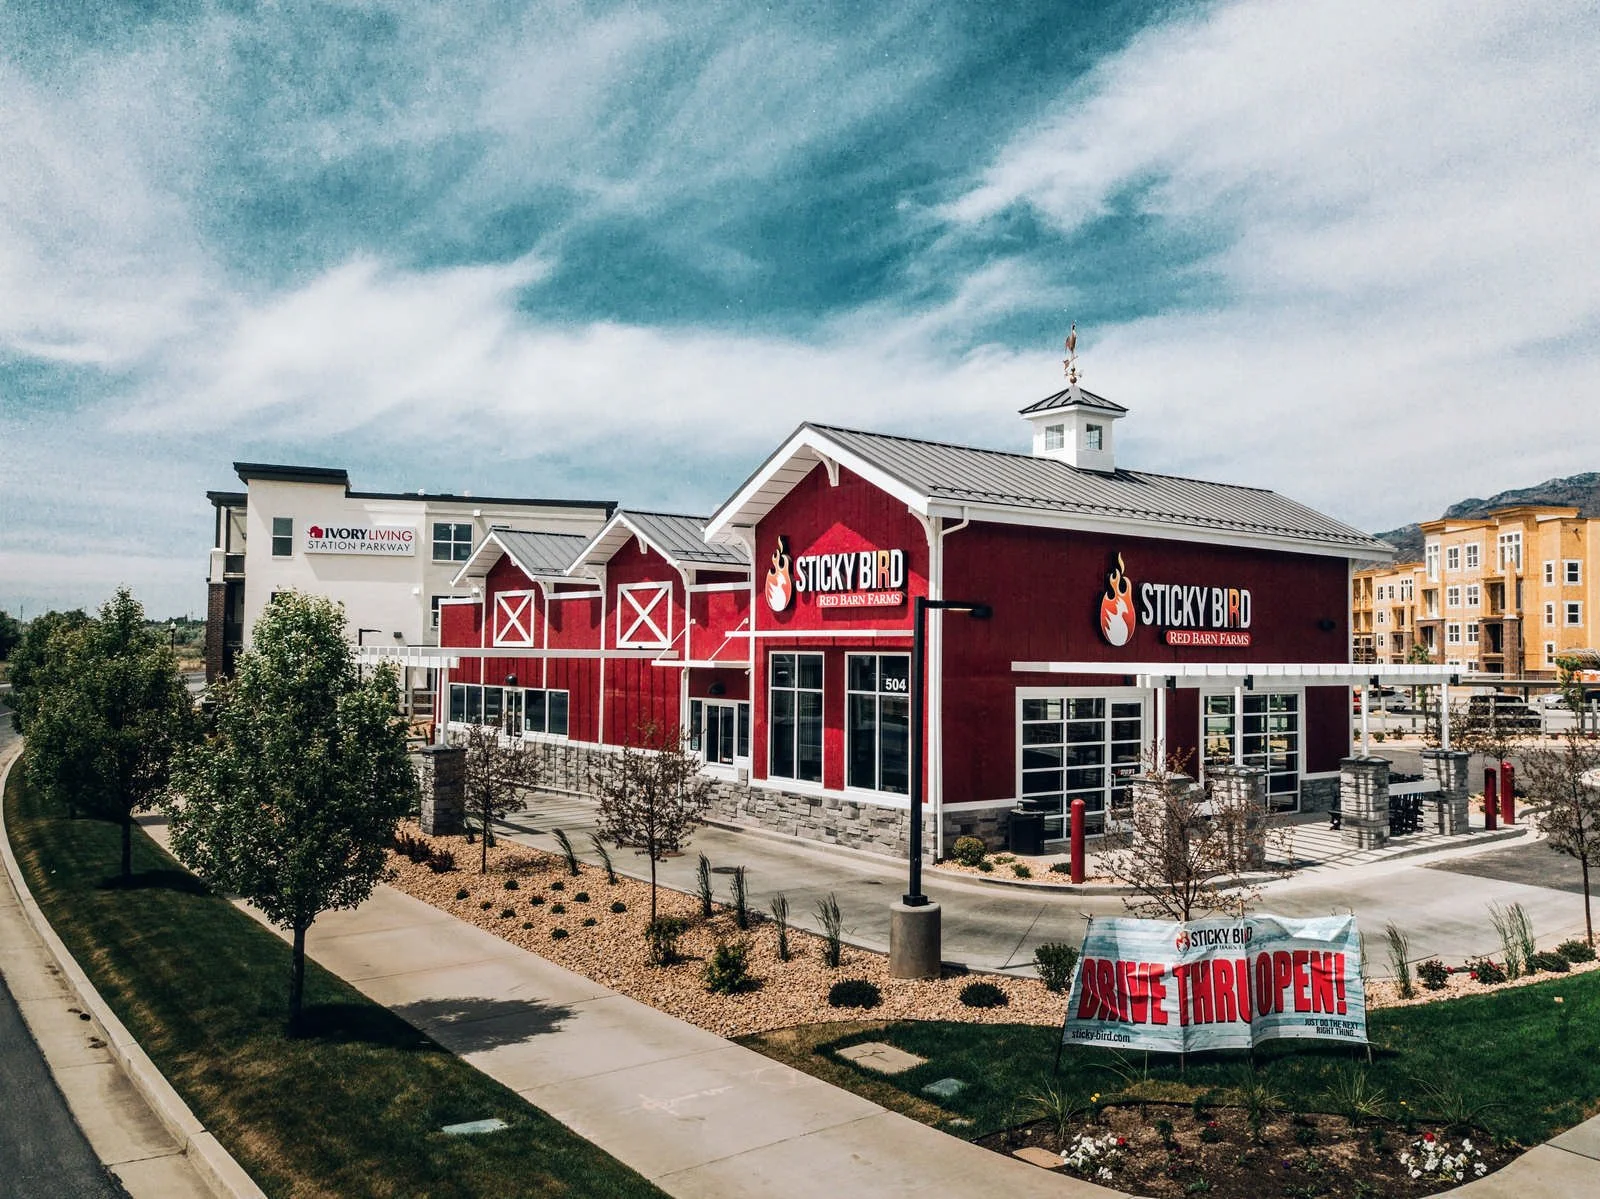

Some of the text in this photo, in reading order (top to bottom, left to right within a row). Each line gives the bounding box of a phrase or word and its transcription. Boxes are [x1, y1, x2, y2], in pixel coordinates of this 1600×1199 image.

[325, 528, 413, 542] IVORY LIVING
[308, 540, 410, 552] STATION PARKWAY
[796, 548, 904, 592] STICKY BIRD
[819, 593, 900, 606] RED BARN FARMS
[1141, 583, 1251, 629] STICKY BIRD
[1170, 631, 1249, 645] RED BARN FARMS
[885, 678, 906, 691] 504
[1191, 928, 1230, 947] STICKY
[1078, 950, 1347, 1026] DRIVE THRU OPEN!
[1071, 1028, 1130, 1043] sticky-bird.com
